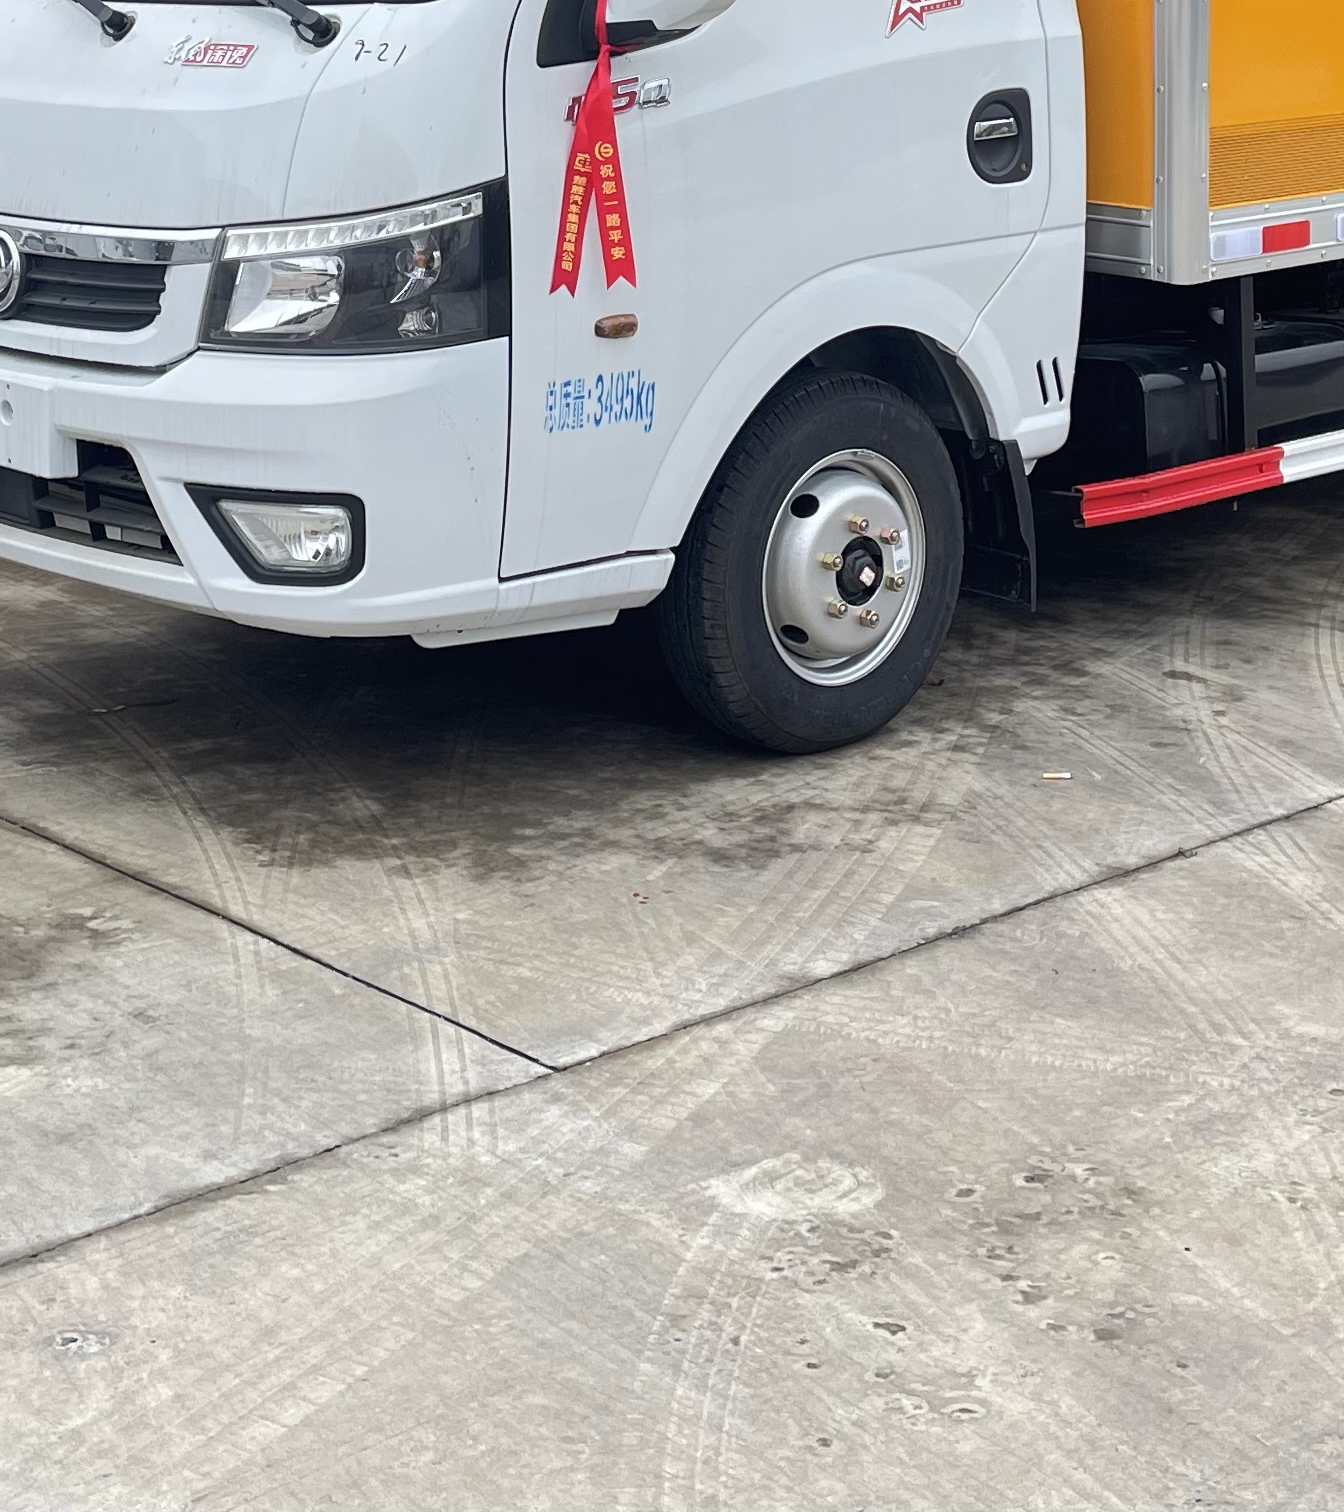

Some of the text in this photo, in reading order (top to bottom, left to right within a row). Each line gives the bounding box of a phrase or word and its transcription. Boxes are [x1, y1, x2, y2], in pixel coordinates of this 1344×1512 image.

[599, 163, 627, 261] 祝您一路平安
